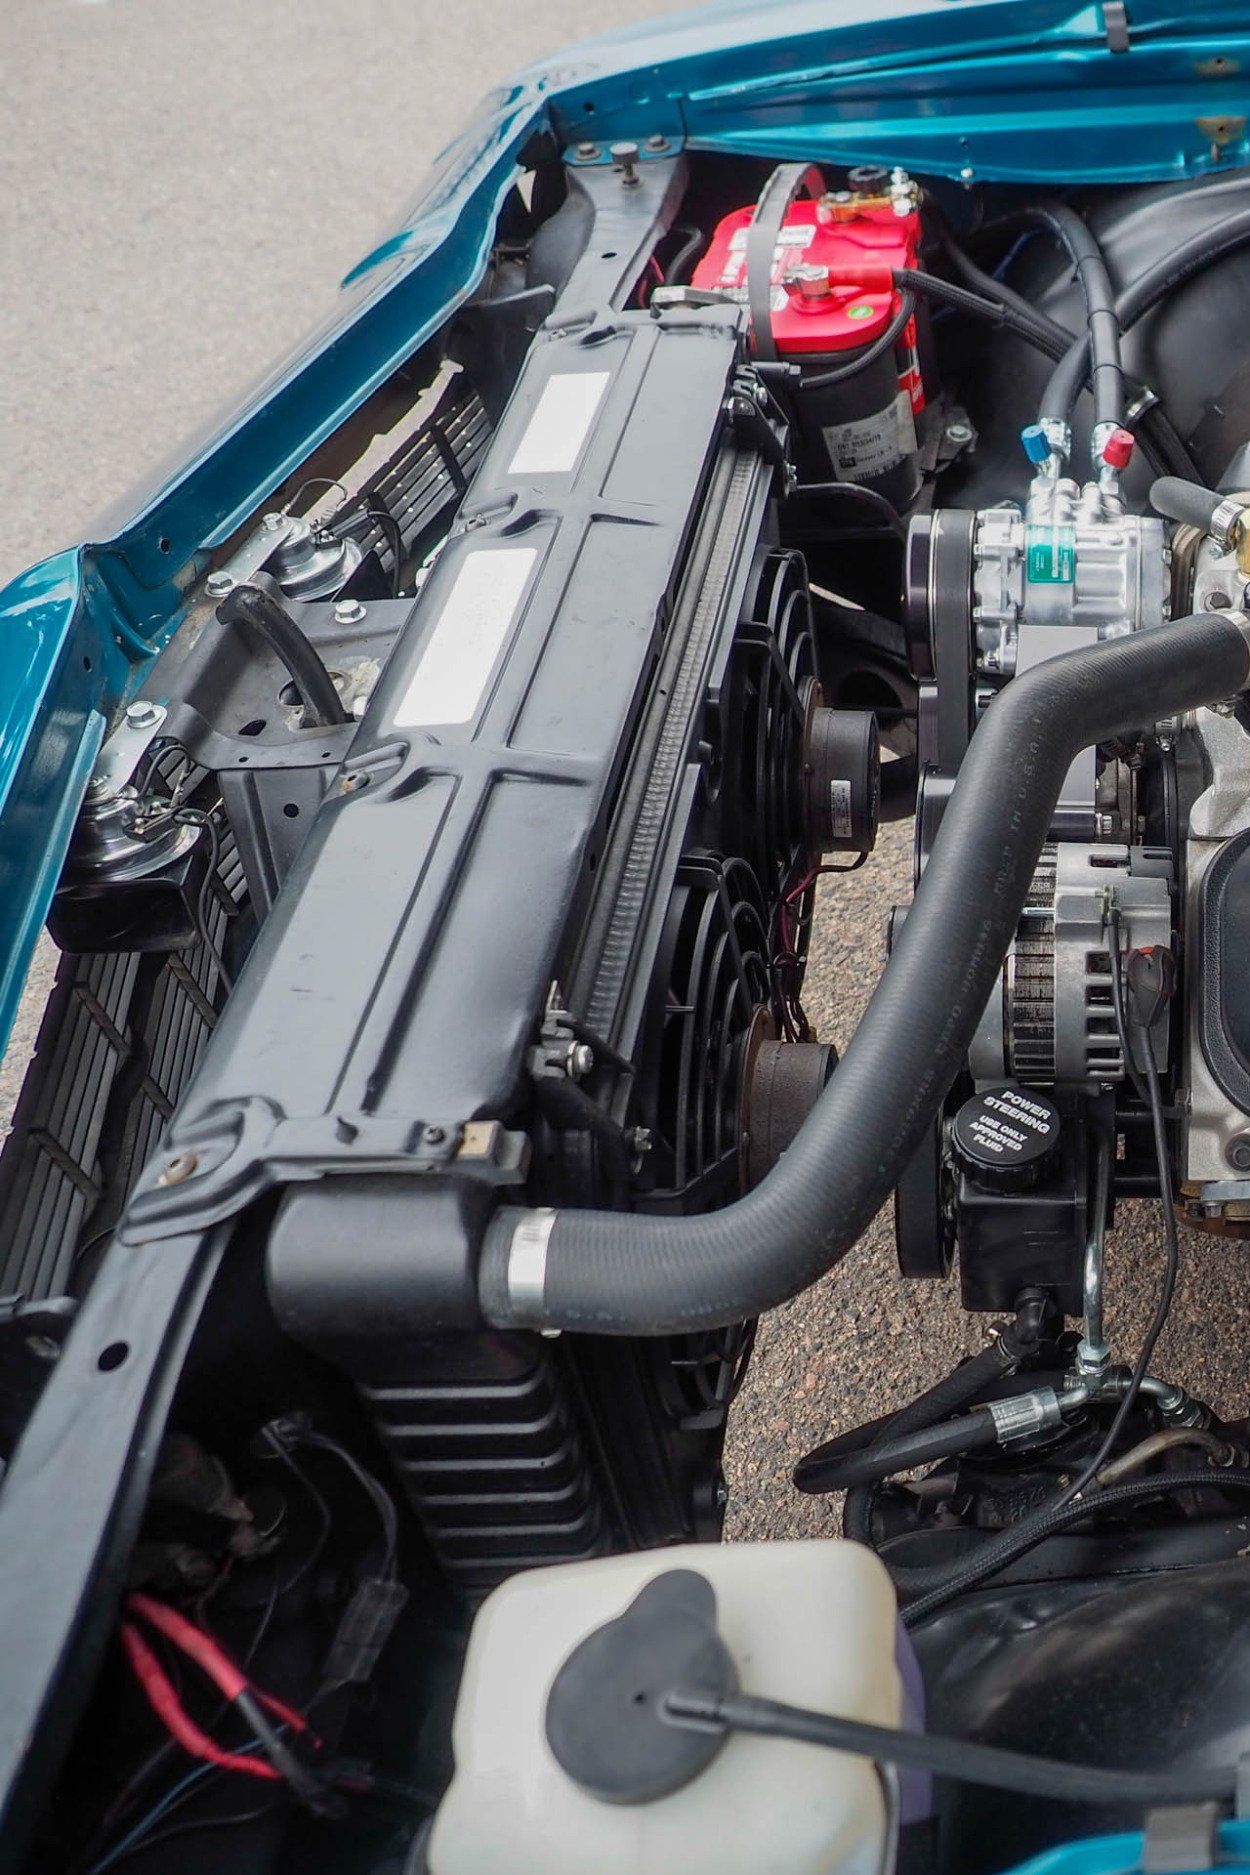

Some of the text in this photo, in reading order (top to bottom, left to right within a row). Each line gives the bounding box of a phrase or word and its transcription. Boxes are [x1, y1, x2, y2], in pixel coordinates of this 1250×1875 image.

[984, 1096, 1051, 1134] STEERING
[1002, 1091, 1051, 1119] POWER
[970, 1122, 1022, 1151] APPROVED
[979, 1115, 1028, 1141] USE ONLY
[973, 1134, 1003, 1152] FLUID
